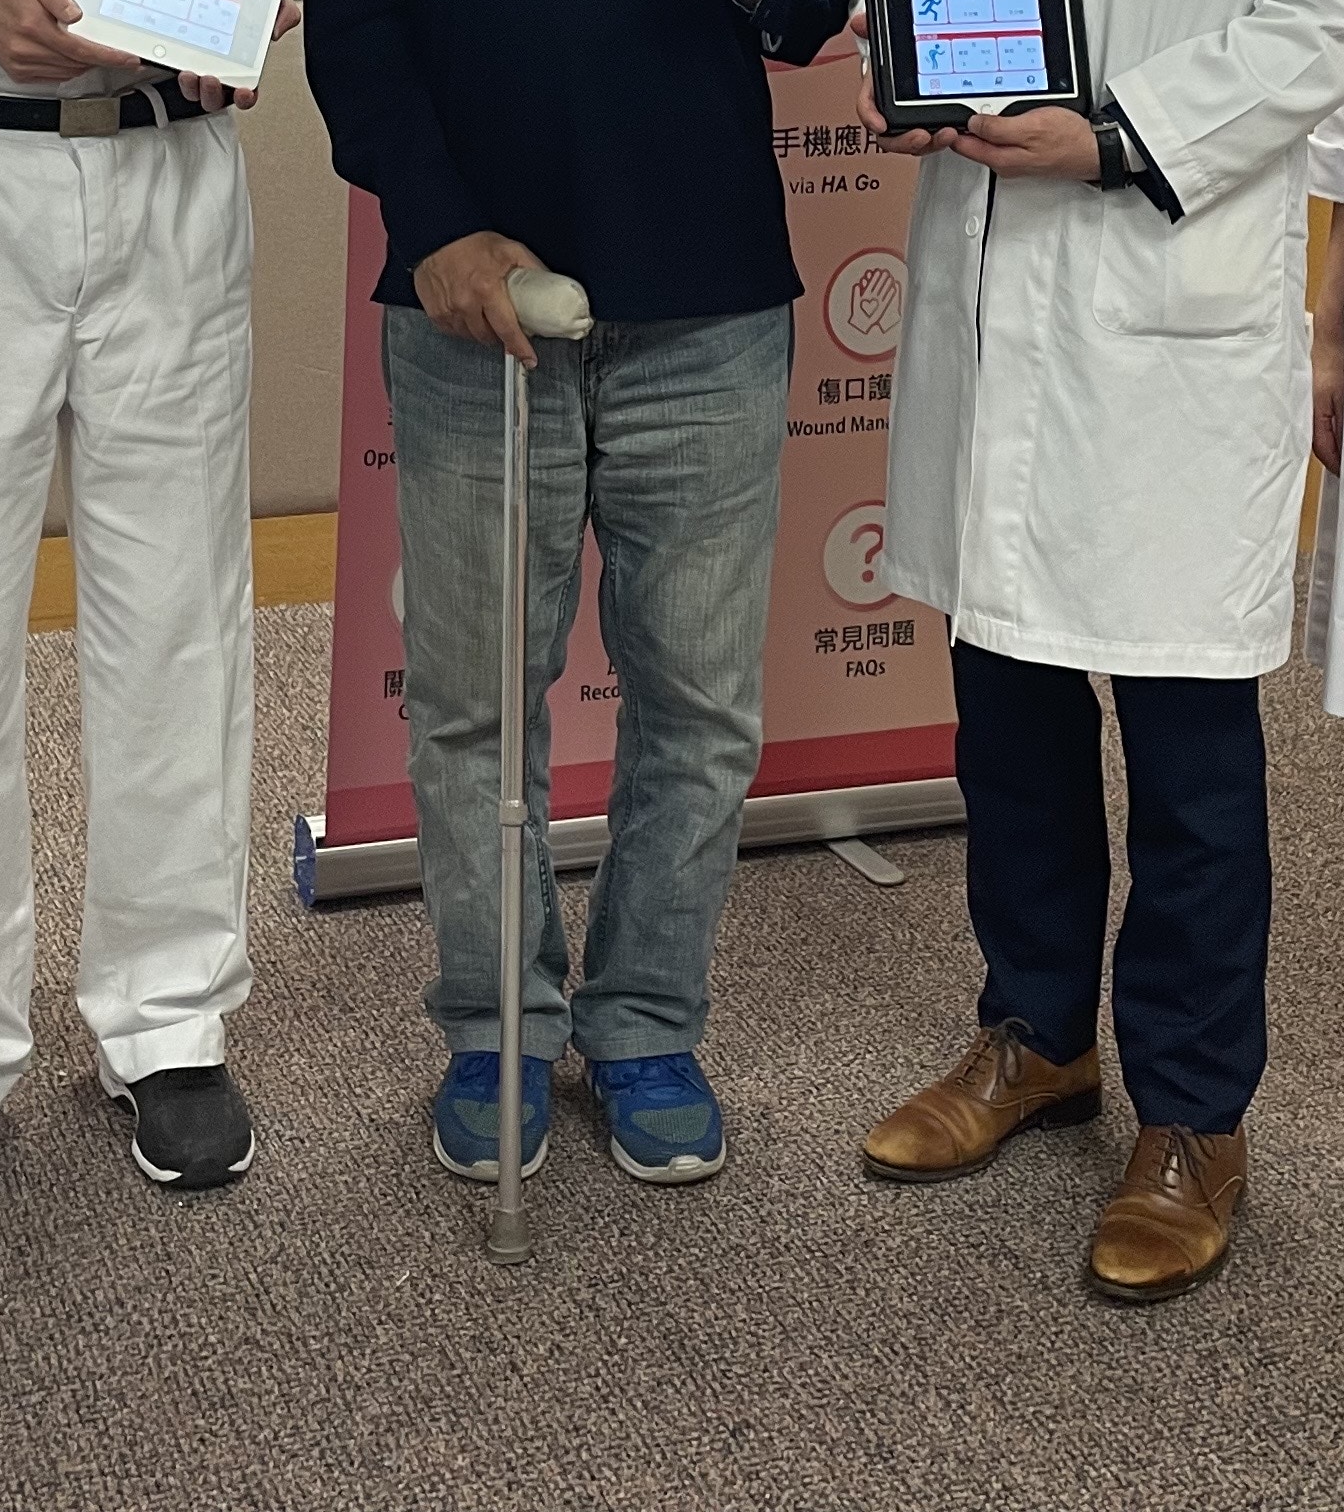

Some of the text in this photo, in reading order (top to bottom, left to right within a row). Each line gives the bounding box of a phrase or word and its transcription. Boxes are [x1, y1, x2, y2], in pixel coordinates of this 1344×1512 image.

[788, 173, 880, 194] via HA Go
[787, 416, 846, 437] Wound
[814, 619, 915, 654] 常見問題
[845, 659, 886, 678] FAQs
